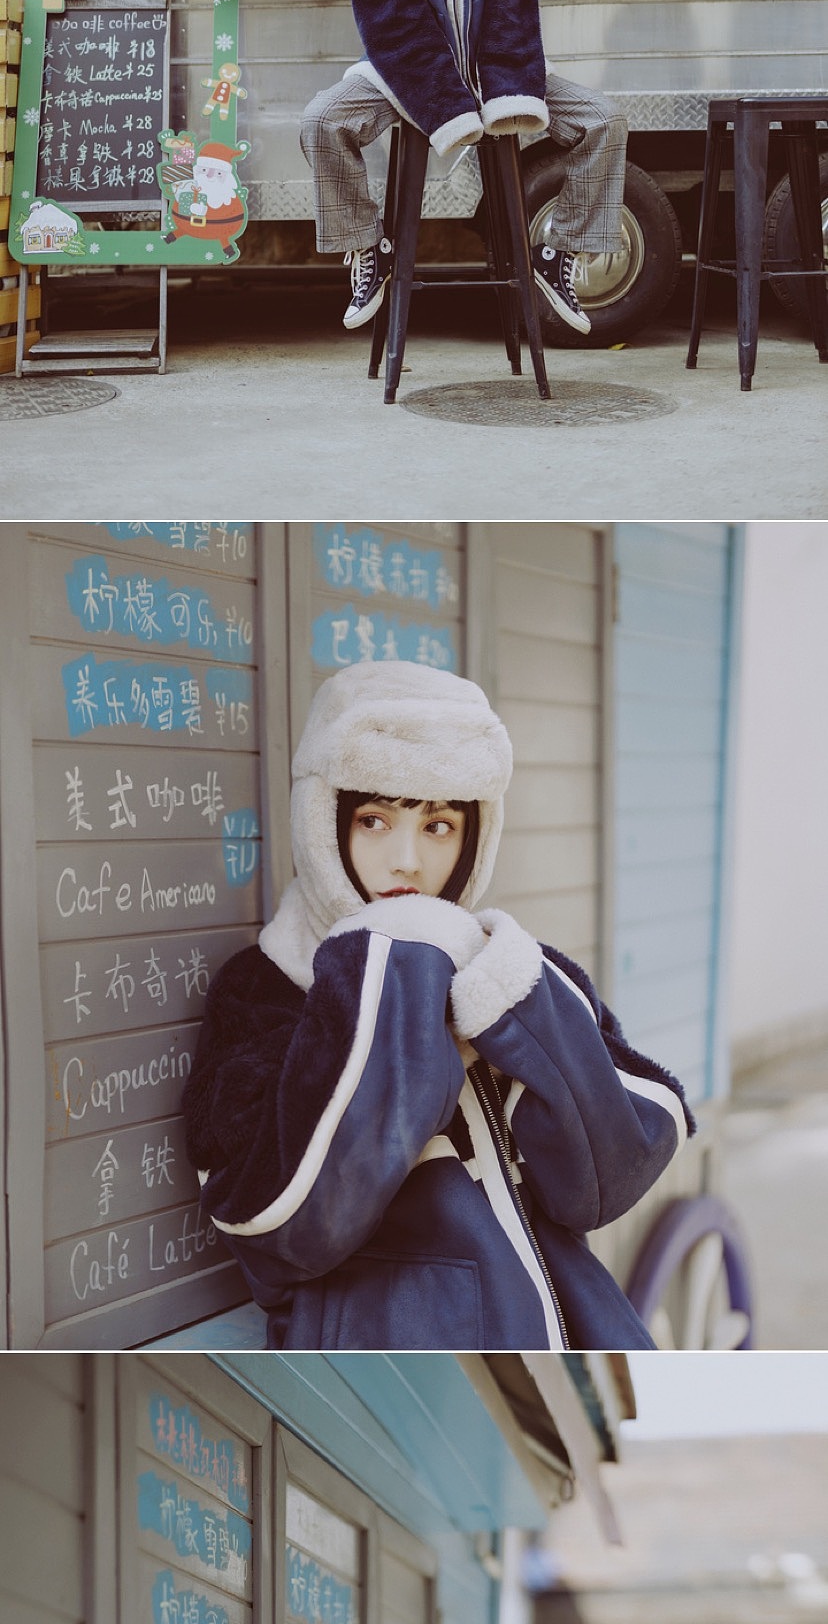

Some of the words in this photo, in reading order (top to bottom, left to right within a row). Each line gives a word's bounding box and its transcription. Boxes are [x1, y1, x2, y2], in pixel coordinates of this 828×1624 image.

[52, 14, 105, 34] 咖啡
[109, 11, 151, 32] coffee
[44, 34, 120, 61] 美式咖啡
[127, 39, 156, 61] ¥18
[89, 64, 123, 82] Latte
[41, 89, 94, 114] 卡布奇诺
[38, 118, 72, 142] 摩卡
[79, 113, 118, 136] Mocha
[122, 113, 153, 132] ¥28
[121, 139, 154, 160] ¥28
[125, 164, 155, 187] ¥28
[82, 567, 218, 646] 柠檬可乐
[72, 663, 204, 736] 养乐多雪碧
[215, 692, 250, 736] ¥15
[65, 766, 225, 831] 美式咖啡
[56, 861, 132, 918] Cafe
[64, 947, 210, 1024] 卡布奇诺
[92, 1136, 176, 1216] 拿铁
[70, 1231, 131, 1301] Café
